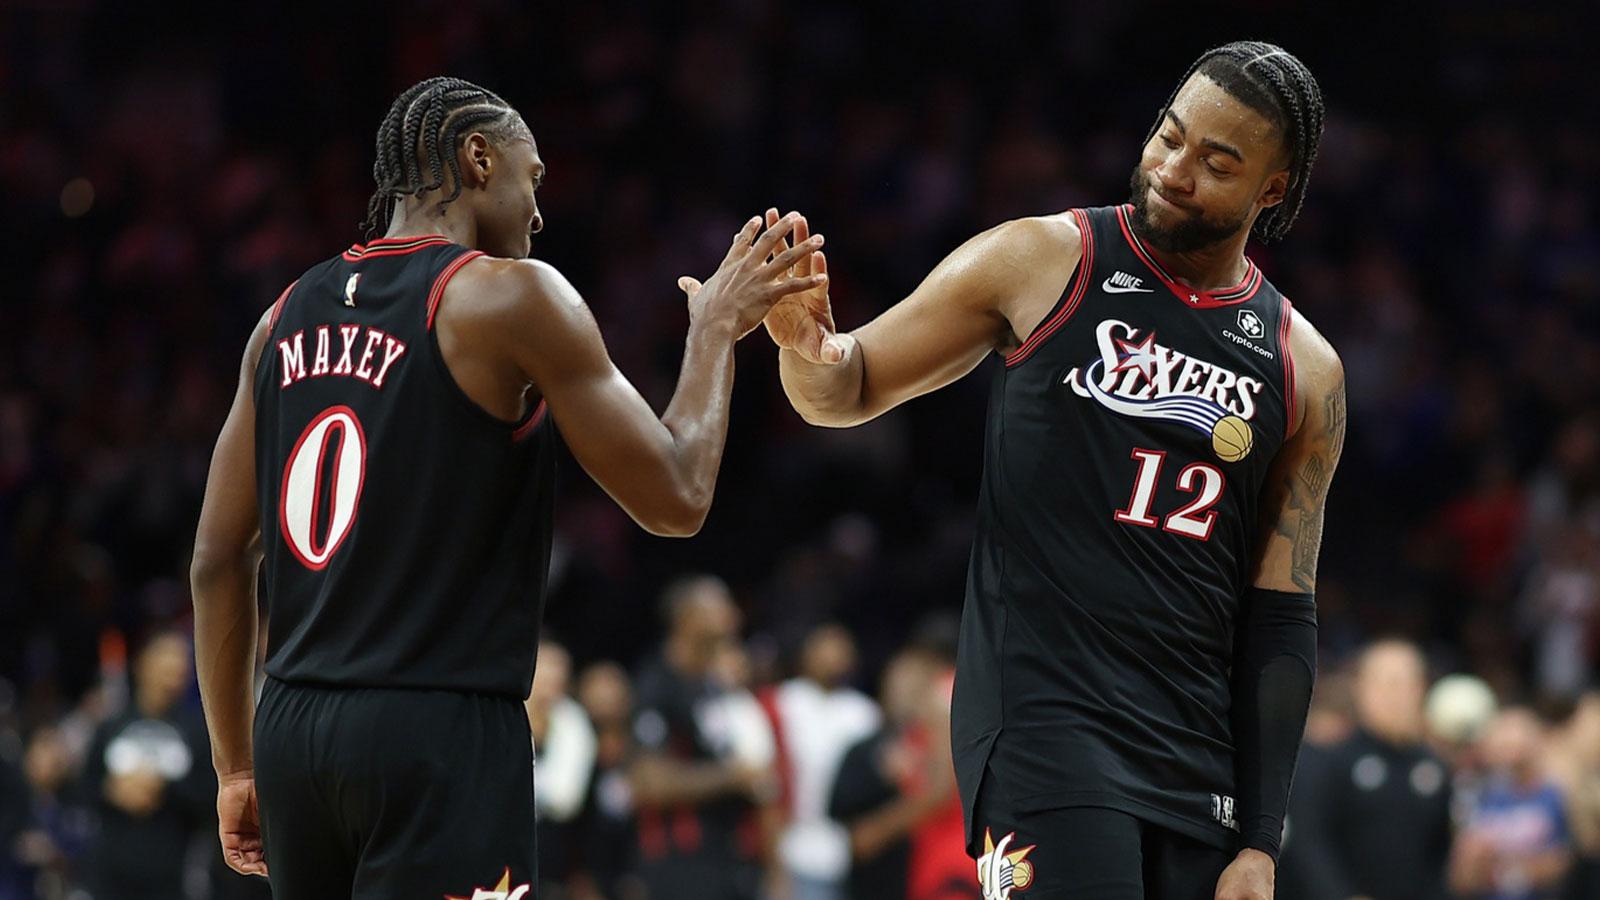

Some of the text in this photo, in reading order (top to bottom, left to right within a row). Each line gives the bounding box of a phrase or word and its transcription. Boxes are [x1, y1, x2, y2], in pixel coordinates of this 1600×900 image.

[1110, 271, 1143, 288] NIKE
[276, 323, 405, 390] MAXEY
[1062, 319, 1263, 421] SIXERS
[1222, 329, 1274, 360] crypto.com
[279, 405, 367, 571] 0
[1114, 447, 1226, 541] 12
